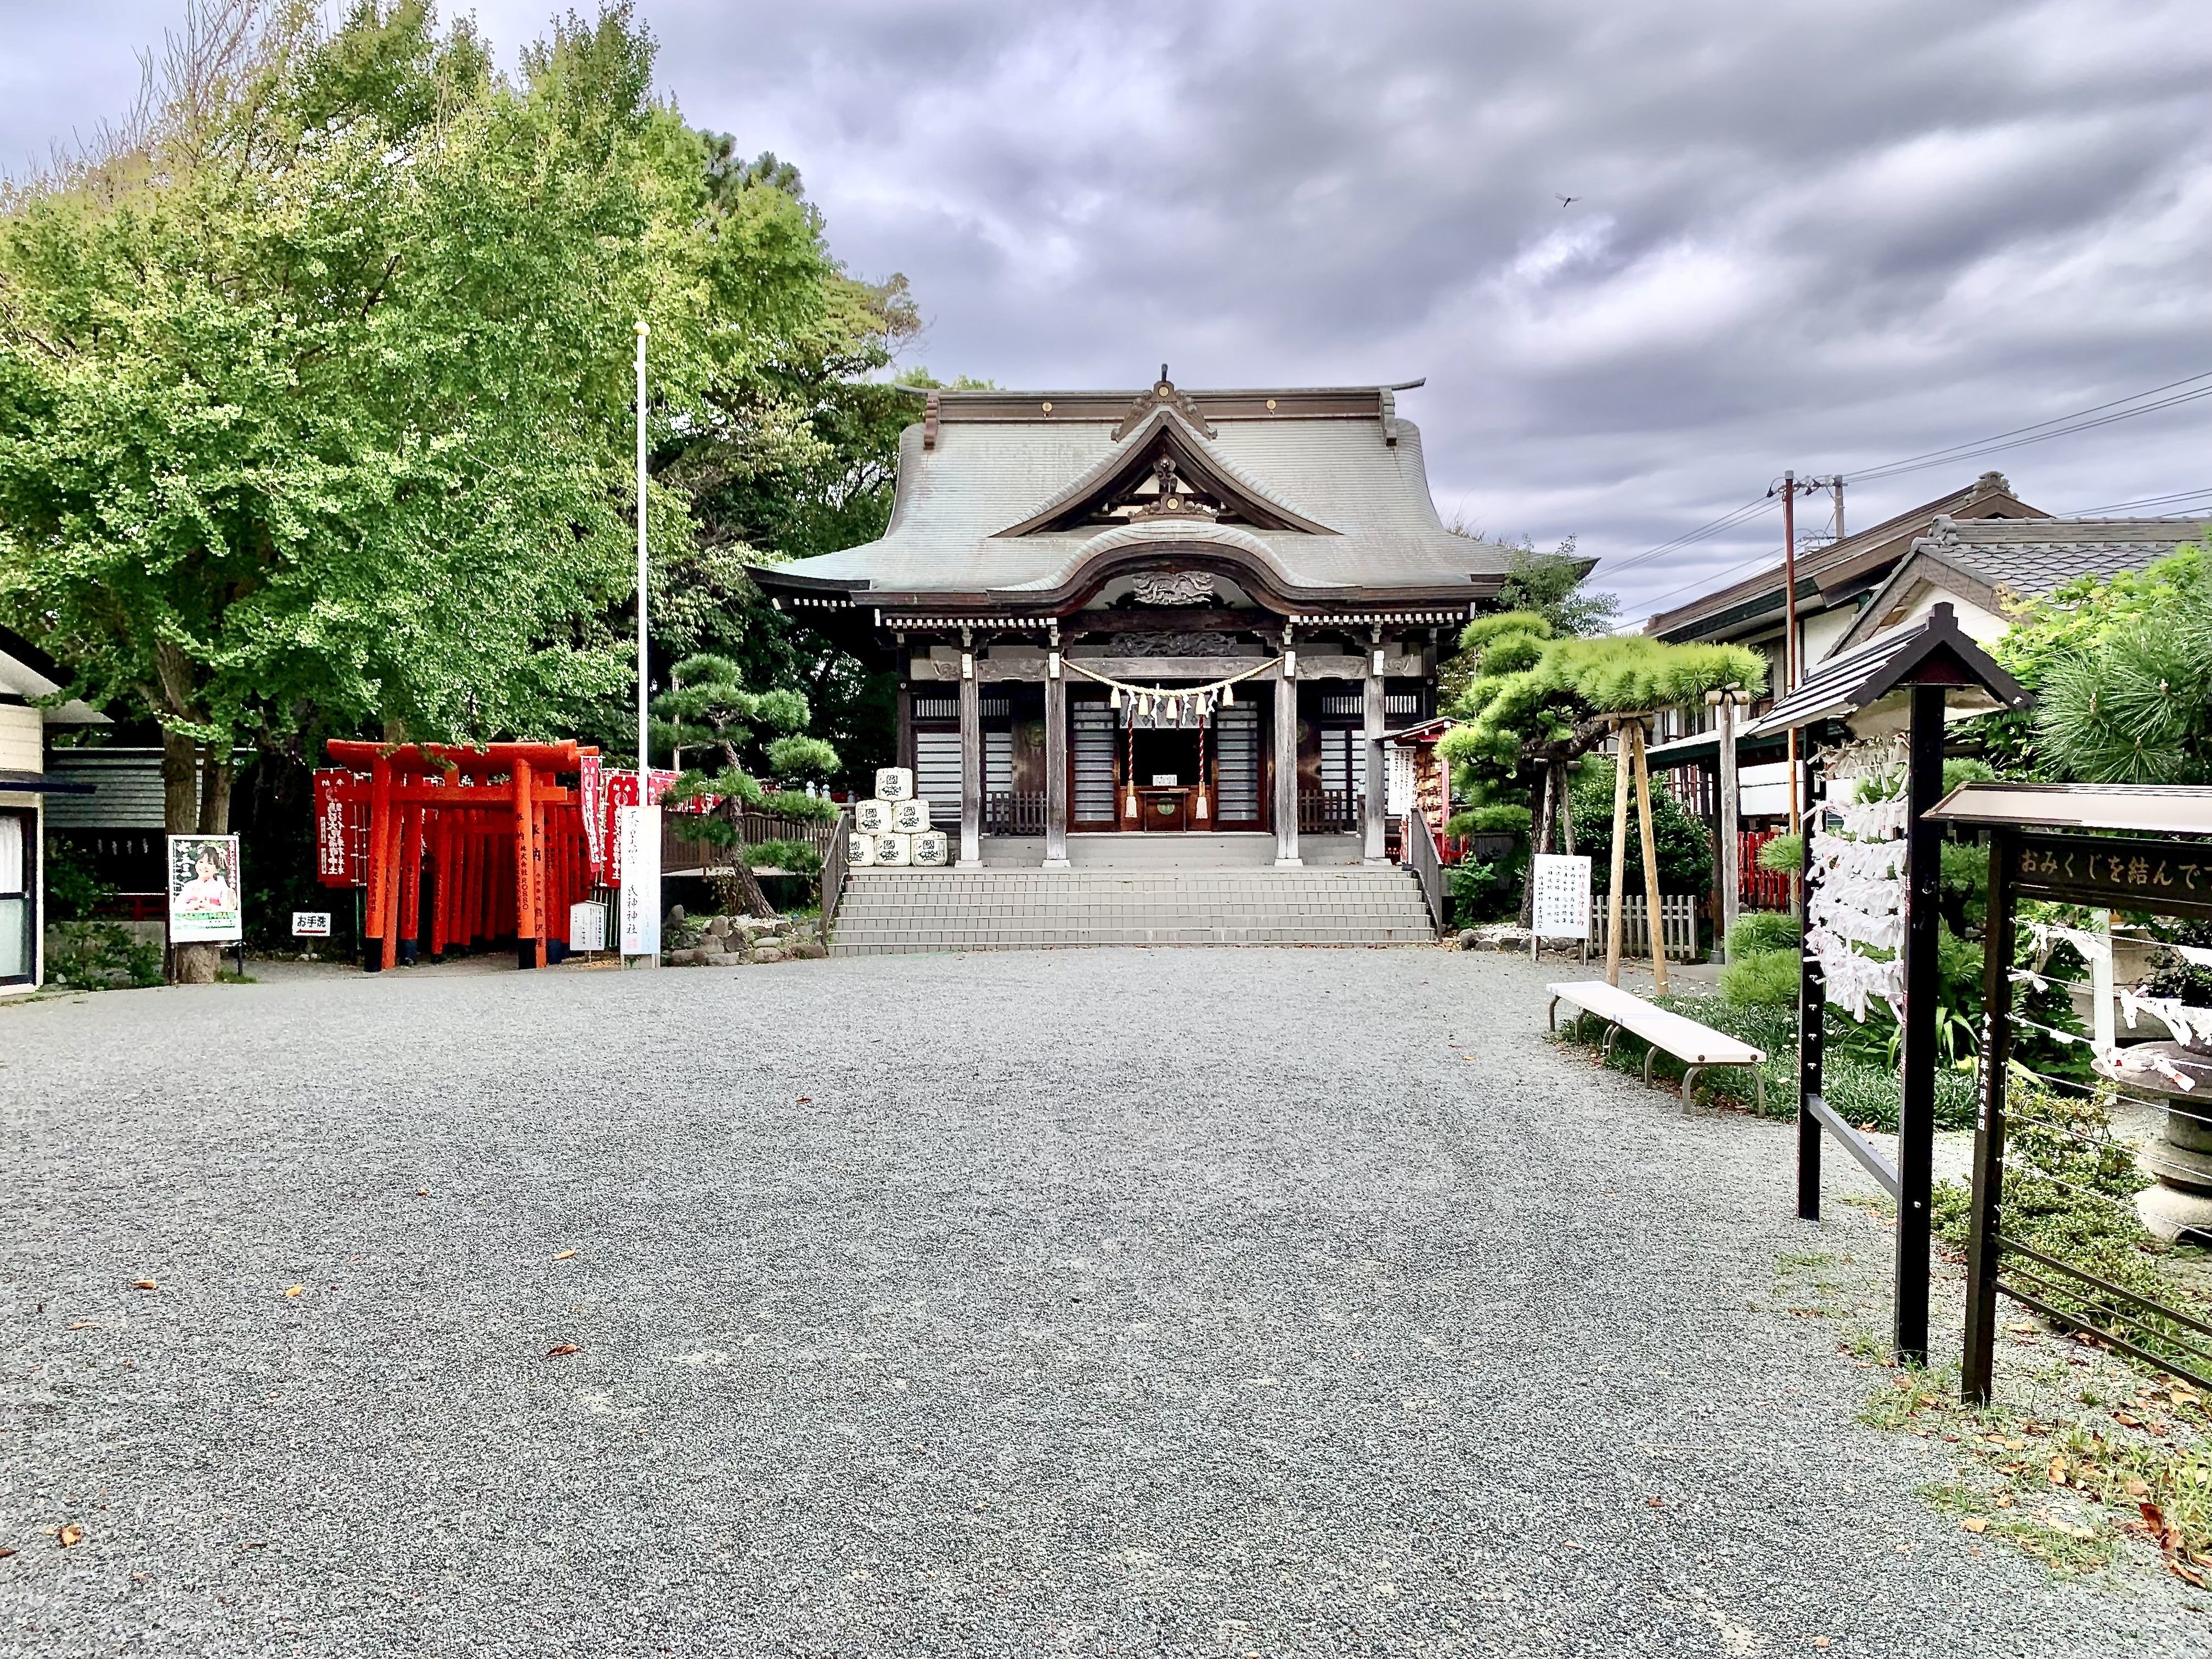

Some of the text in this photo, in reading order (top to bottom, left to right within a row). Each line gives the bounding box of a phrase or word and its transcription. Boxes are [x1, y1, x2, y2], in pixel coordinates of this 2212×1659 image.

[297, 915, 326, 928] お手洗
[1977, 1012, 1993, 1131] 令和二年六月吉日
